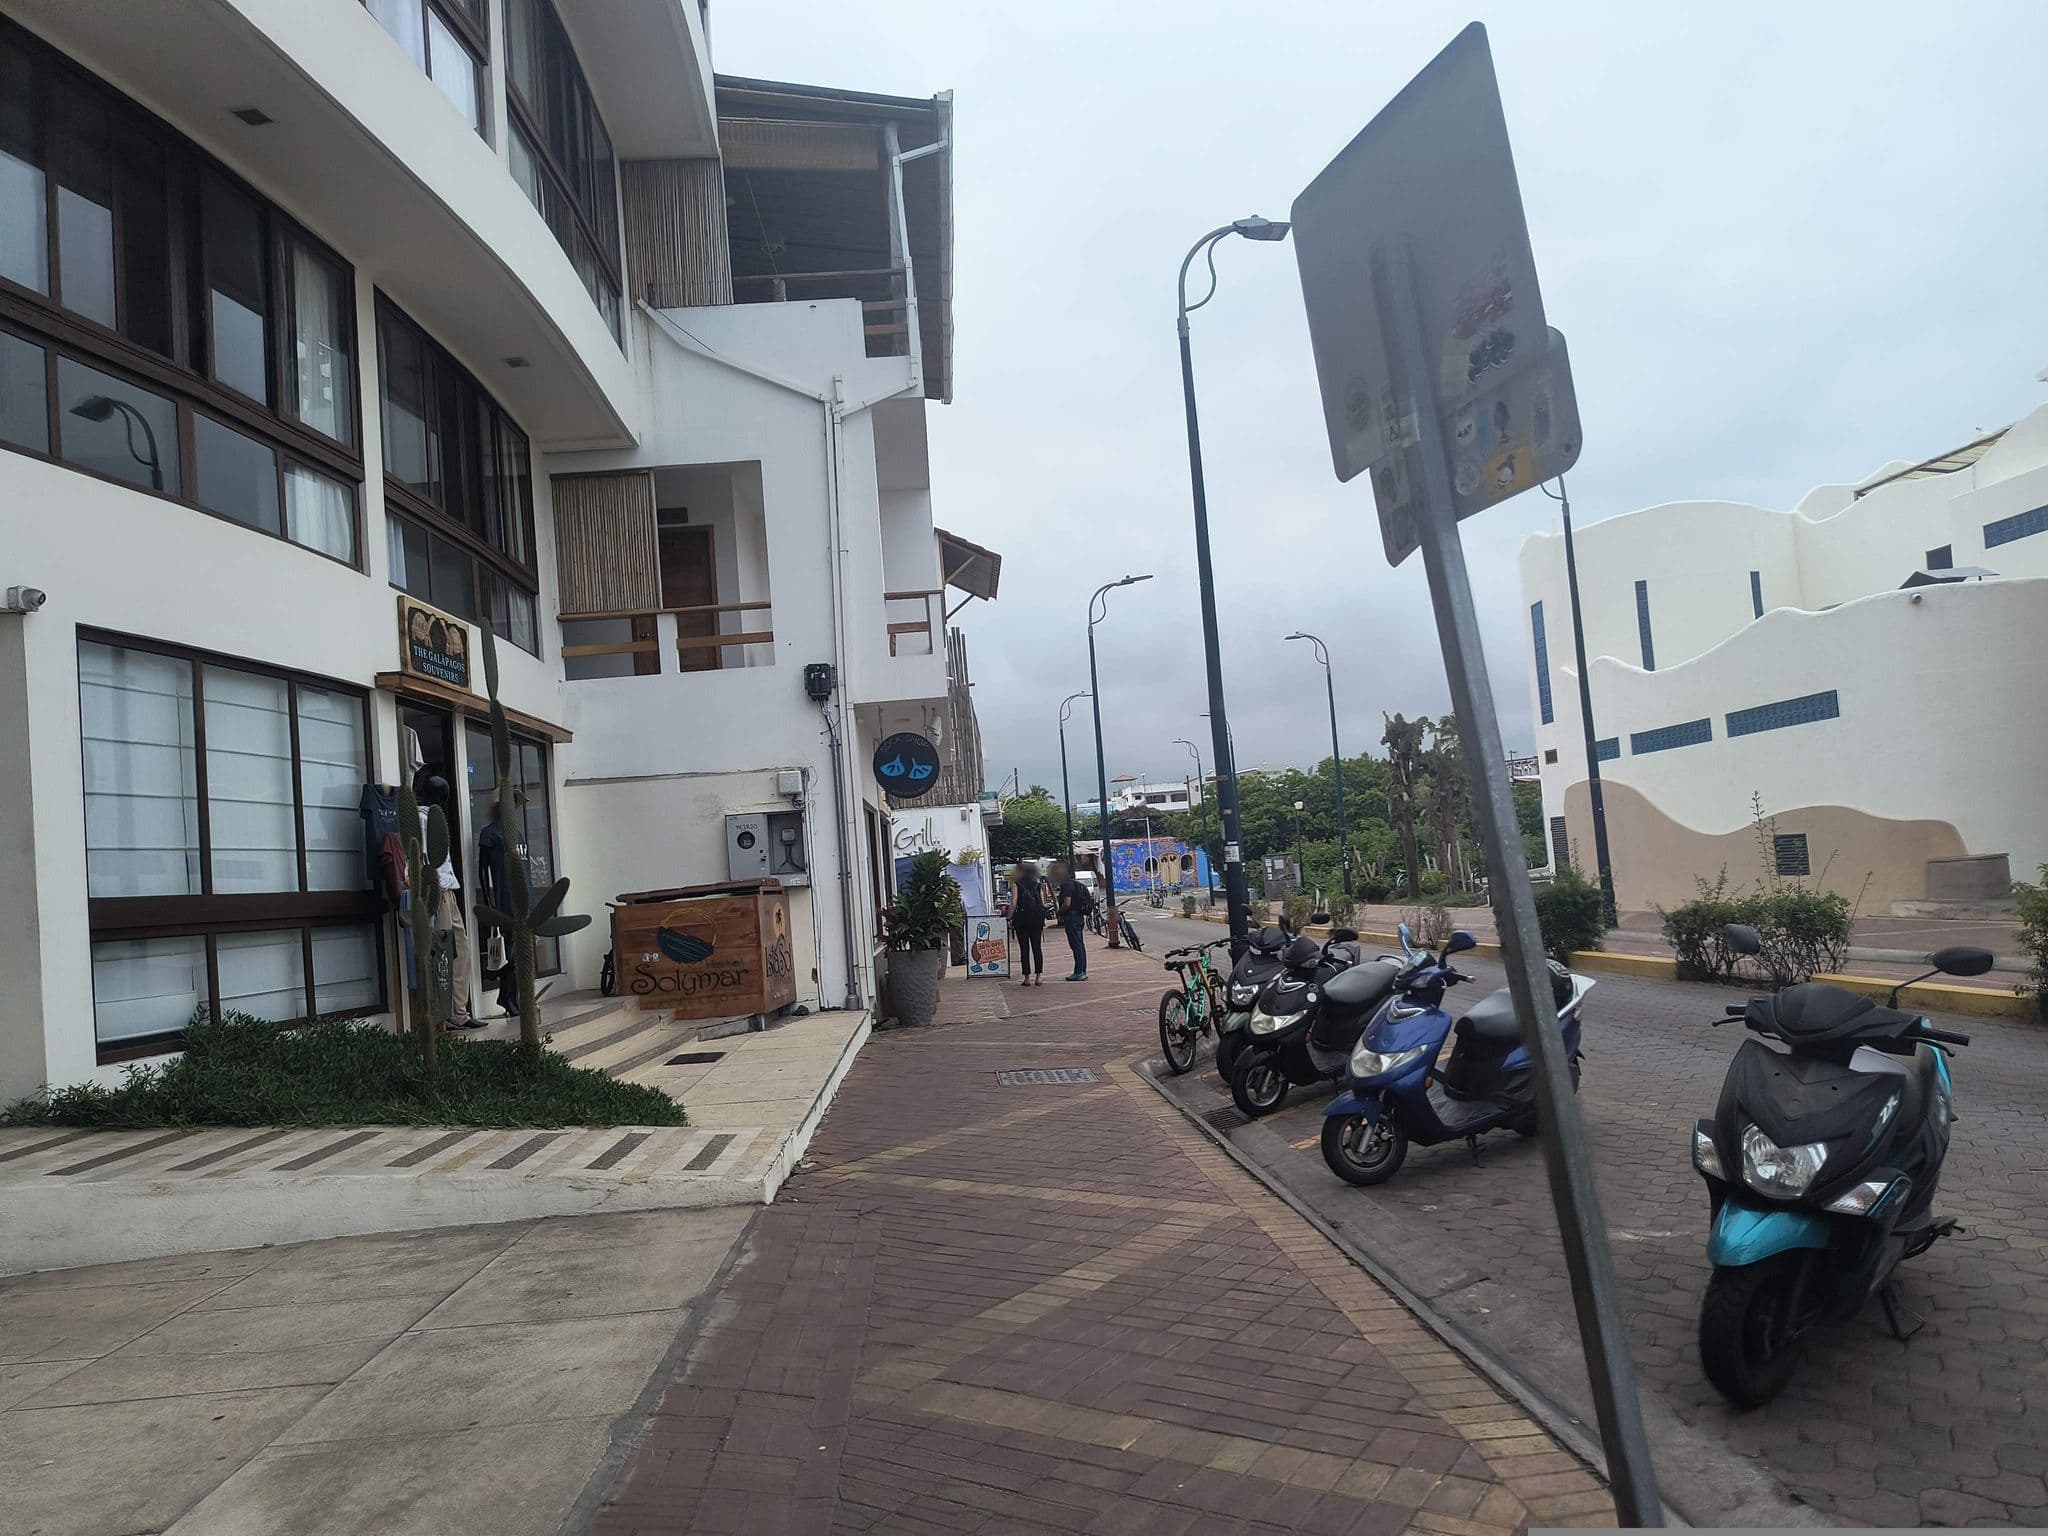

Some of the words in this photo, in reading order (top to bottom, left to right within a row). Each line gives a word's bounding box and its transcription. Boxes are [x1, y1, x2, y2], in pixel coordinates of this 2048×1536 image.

[413, 645, 428, 659] THE
[904, 735, 929, 748] SHOP
[894, 815, 934, 850] Grill
[630, 963, 749, 996] Solymar
